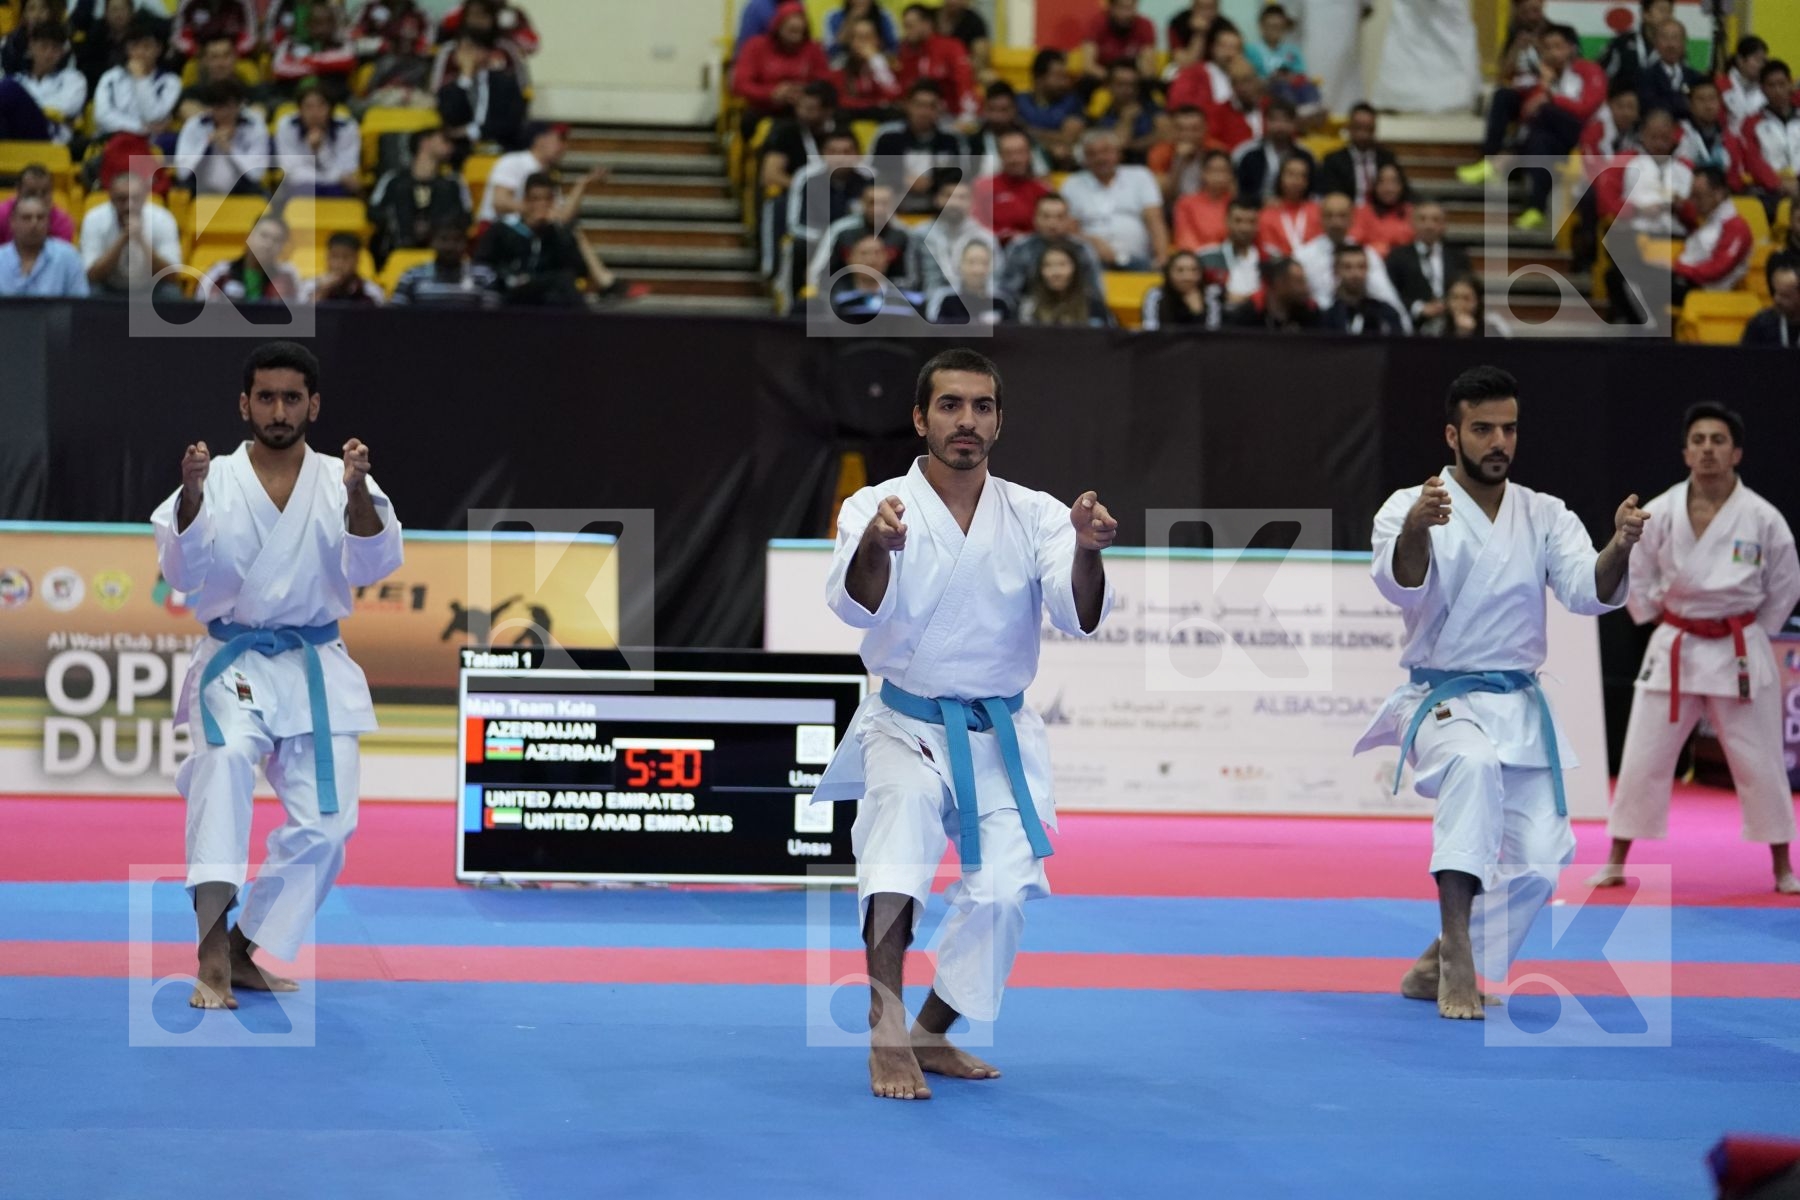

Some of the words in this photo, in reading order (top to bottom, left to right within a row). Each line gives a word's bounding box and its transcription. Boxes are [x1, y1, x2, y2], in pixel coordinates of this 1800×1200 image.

[113, 633, 152, 651] Club
[462, 650, 519, 669] Tatami
[521, 652, 532, 669] 1
[45, 650, 191, 716] OP
[467, 698, 506, 716] Male
[508, 699, 555, 716] Team
[557, 700, 597, 717] Kata
[485, 721, 597, 740] AZERBAIJAN
[44, 717, 194, 775] DUB
[524, 743, 617, 762] AZERBAIJ
[624, 748, 702, 787] 5:30
[485, 790, 551, 808] UNITED
[552, 791, 604, 809] ARAB
[605, 793, 695, 811] EMIRATES
[524, 812, 590, 830] UNITED
[590, 813, 642, 831] ARAB
[643, 815, 734, 832] EMIRATES
[787, 839, 832, 856] Unsu
